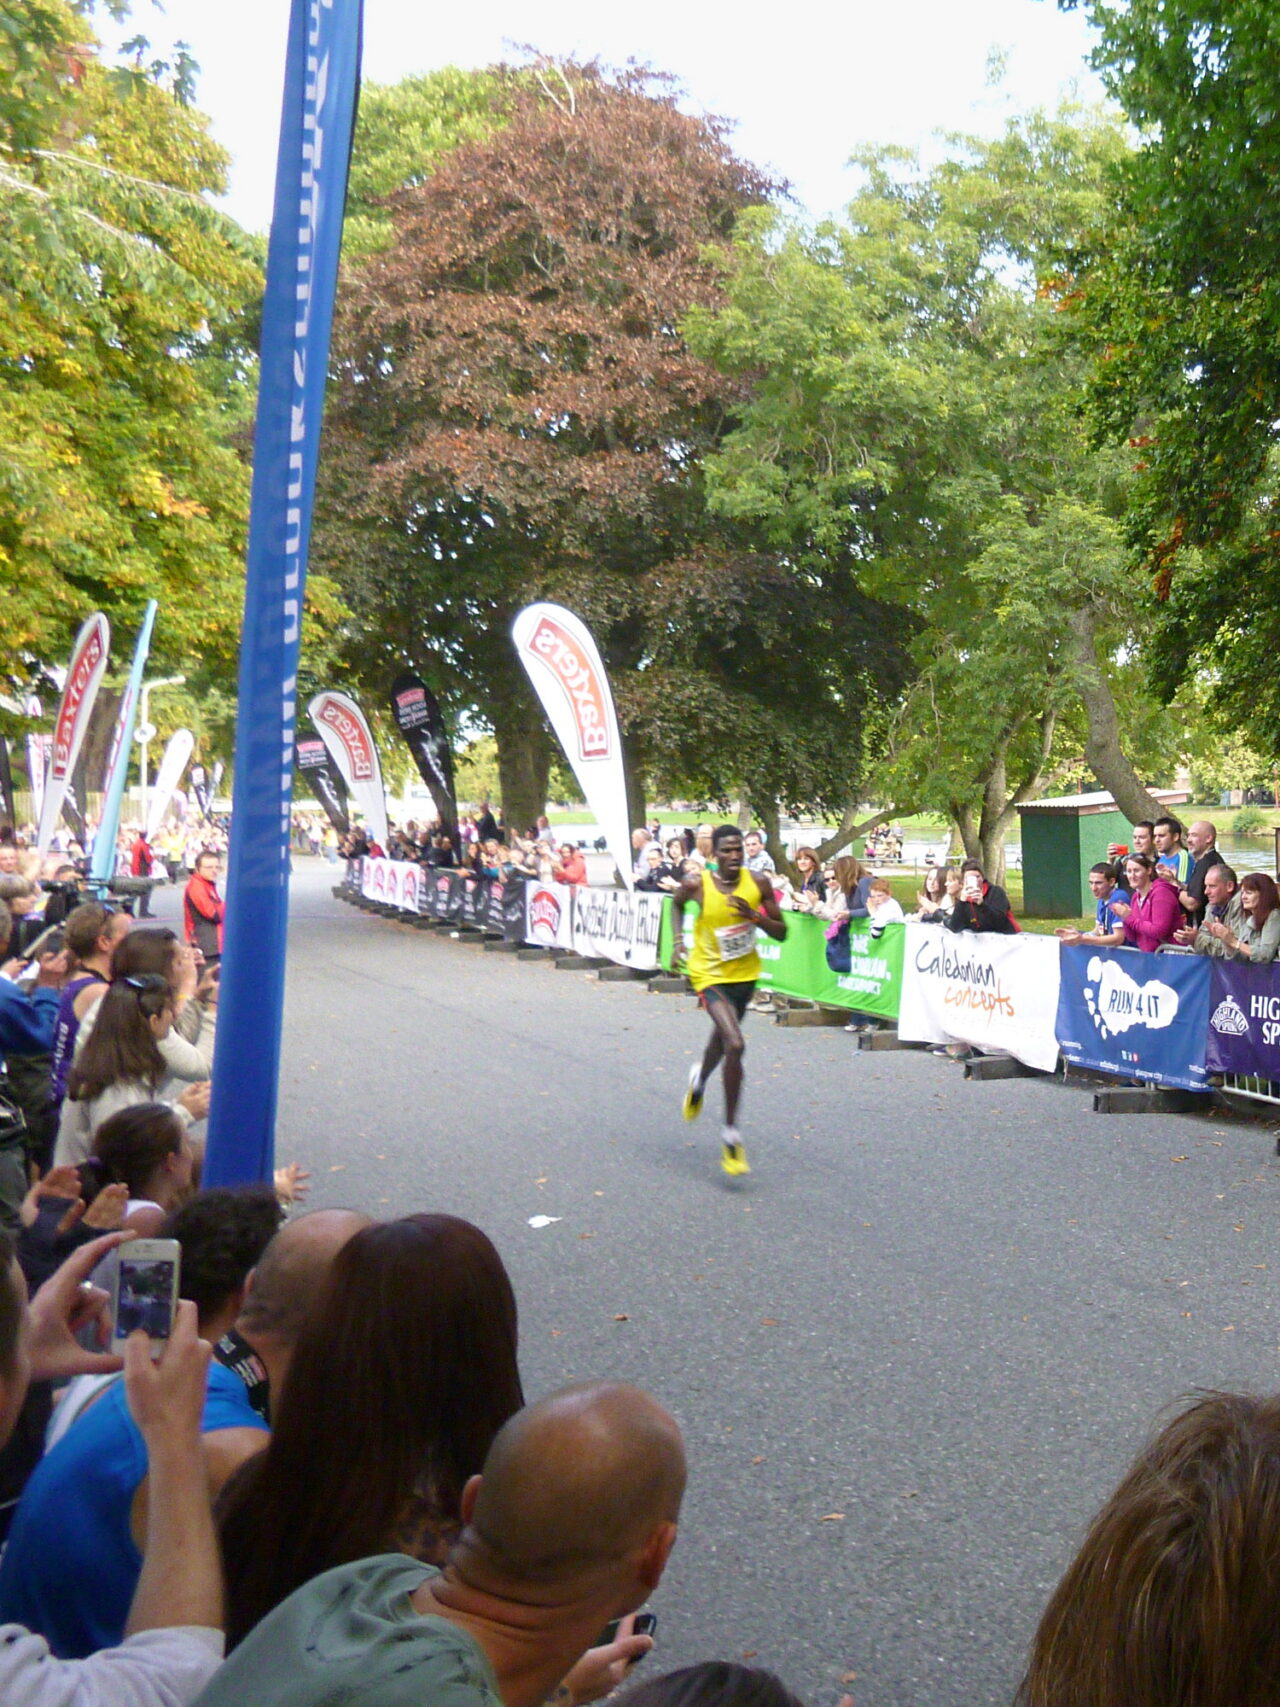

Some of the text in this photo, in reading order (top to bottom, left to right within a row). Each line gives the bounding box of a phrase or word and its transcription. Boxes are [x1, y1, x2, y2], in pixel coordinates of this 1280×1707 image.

[915, 941, 996, 987] Caledonian
[944, 978, 1015, 1028] concepts
[1107, 989, 1159, 1018] RUN 4 IT
[1212, 1006, 1245, 1031] HIGHLAND
